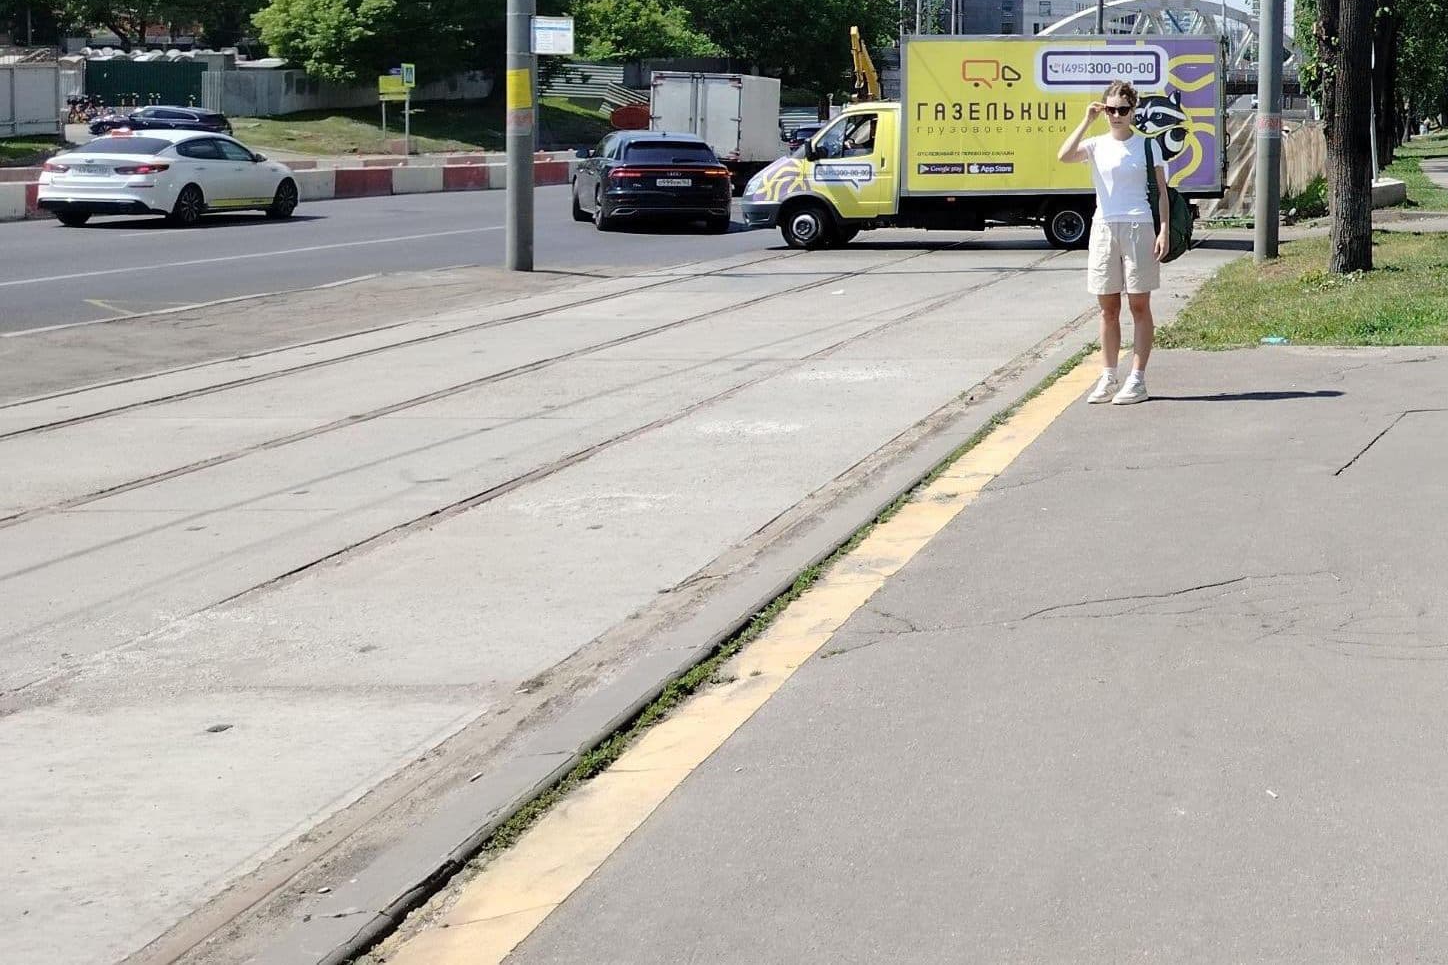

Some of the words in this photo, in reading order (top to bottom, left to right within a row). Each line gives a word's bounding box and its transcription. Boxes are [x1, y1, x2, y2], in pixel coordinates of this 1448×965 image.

[916, 102, 1066, 120] ГАЗЕЛЬКИН
[916, 126, 1004, 136] грузовое
[1016, 125, 1067, 133] такси
